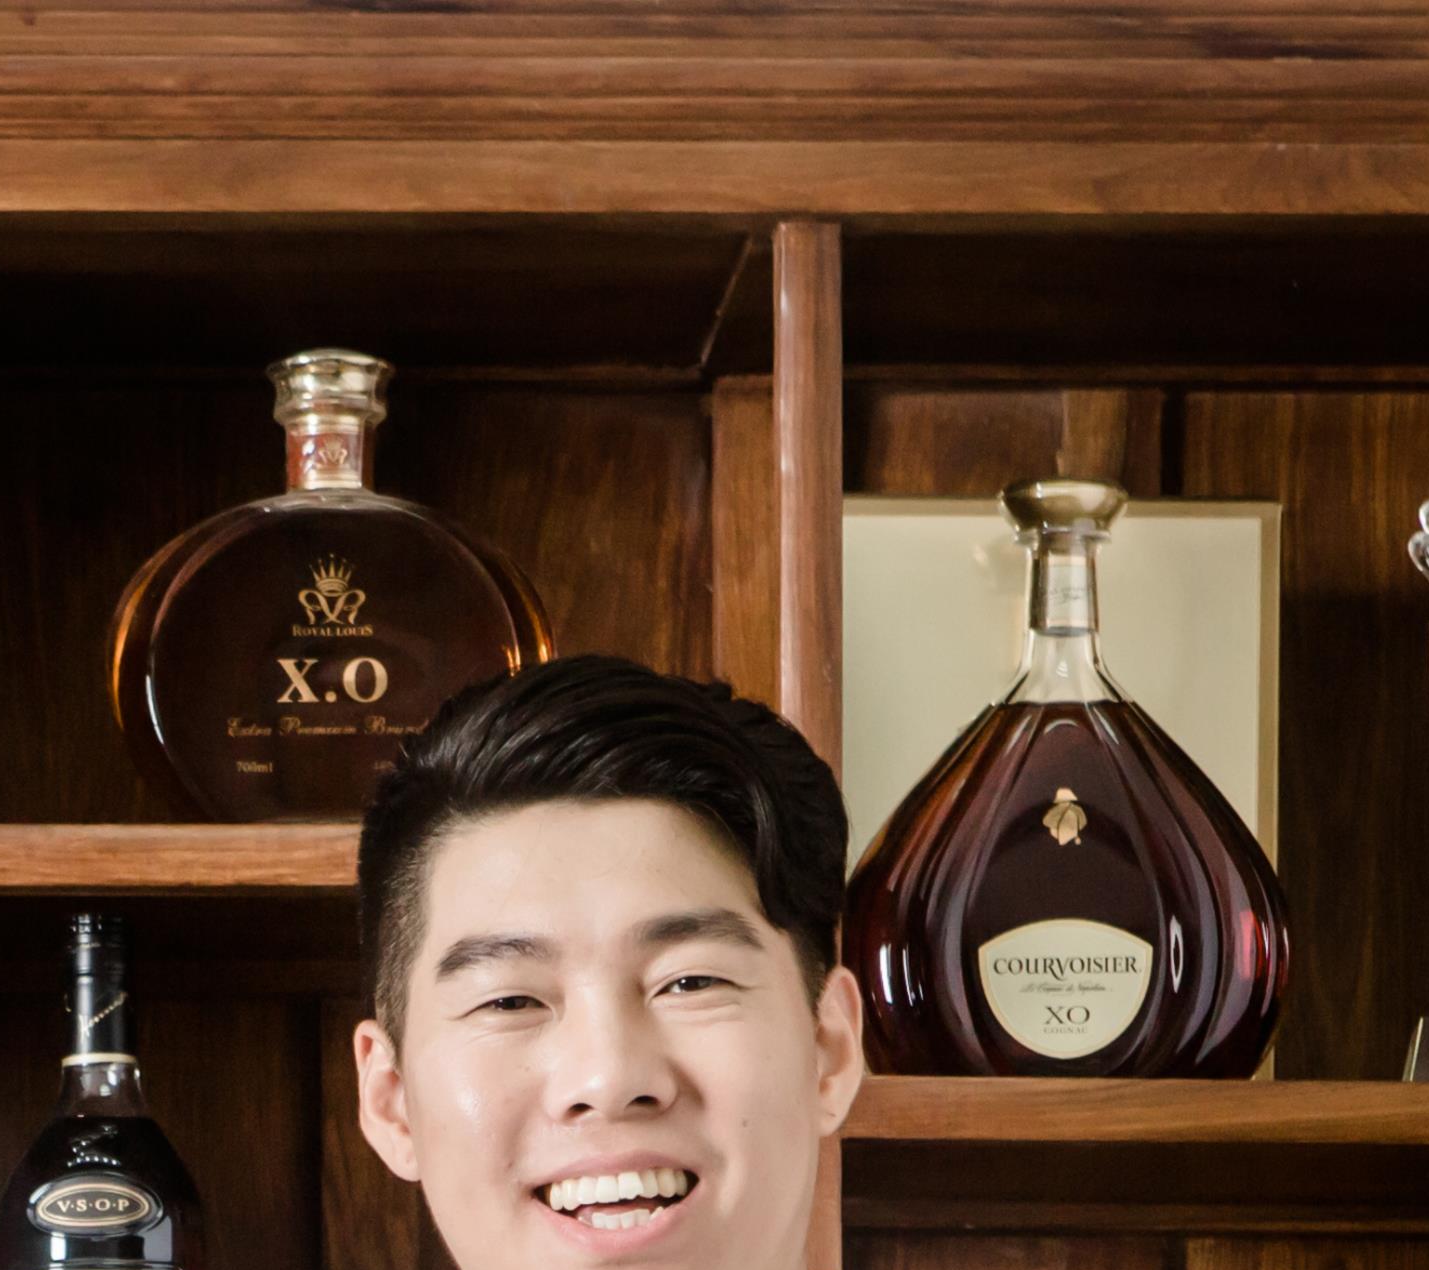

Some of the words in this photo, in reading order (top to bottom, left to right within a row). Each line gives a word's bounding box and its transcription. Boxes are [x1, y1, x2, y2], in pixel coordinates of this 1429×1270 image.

[292, 625, 333, 637] ROYAL
[276, 656, 389, 703] X.O
[993, 956, 1138, 981] COURVOISIER
[1045, 1005, 1091, 1025] XO
[1043, 1026, 1088, 1034] COGNAC
